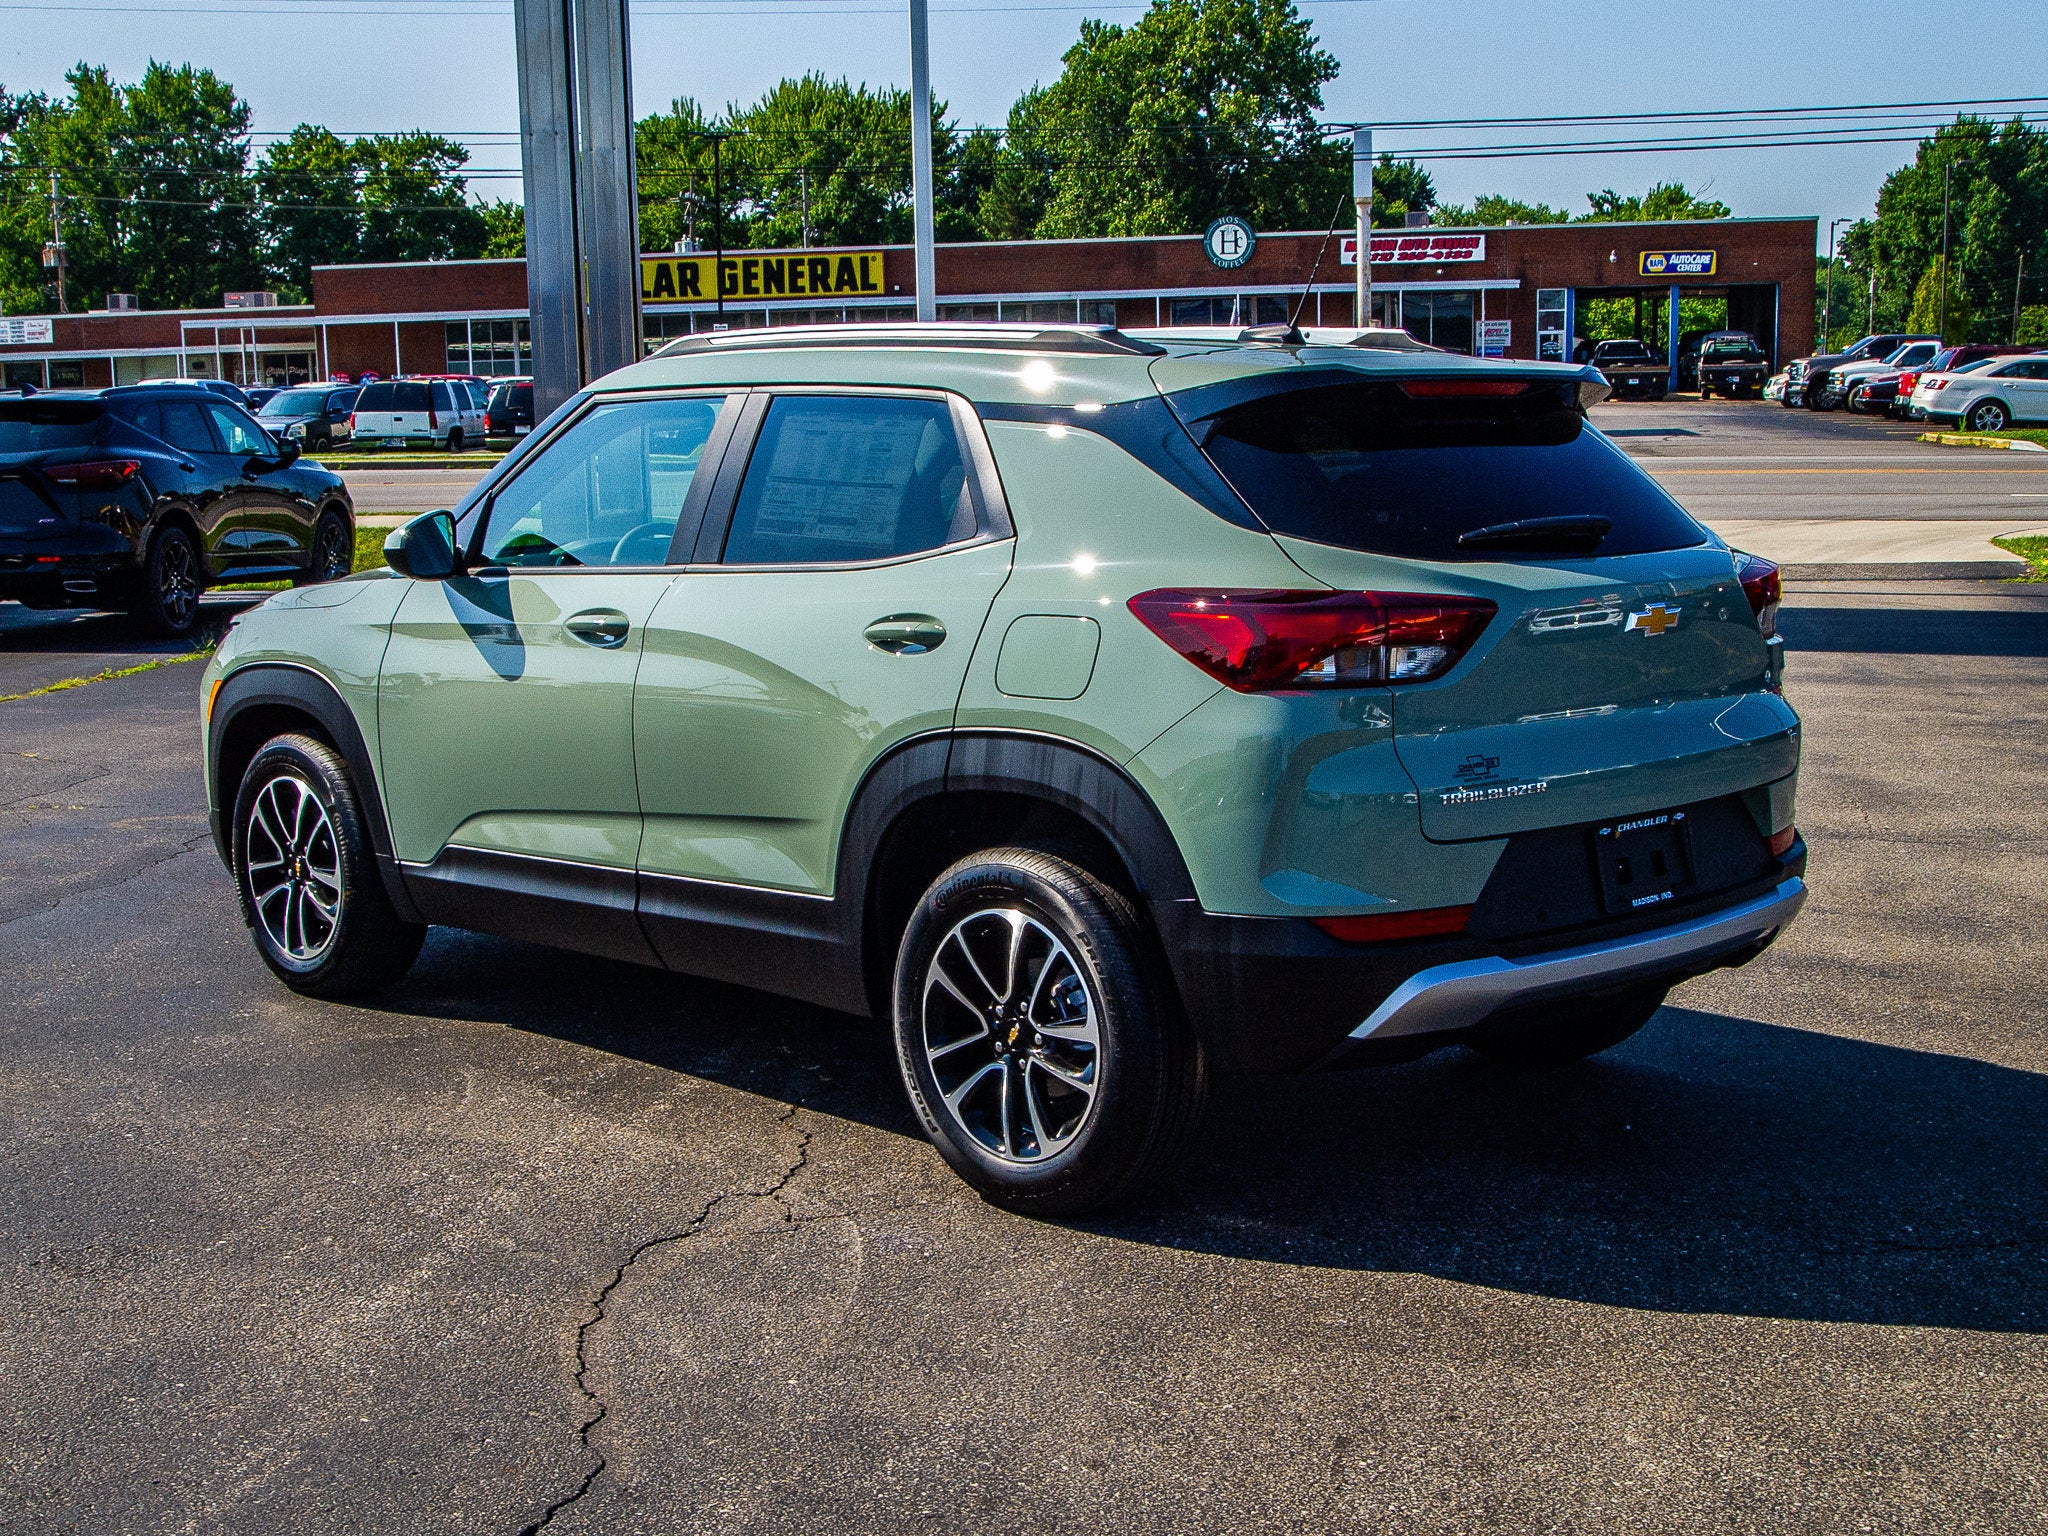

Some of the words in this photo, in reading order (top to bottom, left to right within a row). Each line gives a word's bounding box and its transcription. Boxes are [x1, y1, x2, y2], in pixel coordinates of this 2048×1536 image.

[1398, 238, 1430, 250] AUTO
[1430, 236, 1480, 250] SERVICE
[1213, 257, 1246, 268] COFFEE
[1351, 252, 1394, 262] (12)
[641, 261, 702, 298] LAR
[719, 255, 878, 295] GENERAL
[1439, 781, 1547, 805] TRAILBLAZER
[1617, 815, 1668, 832] CHANDLER
[935, 871, 1003, 911] Continental
